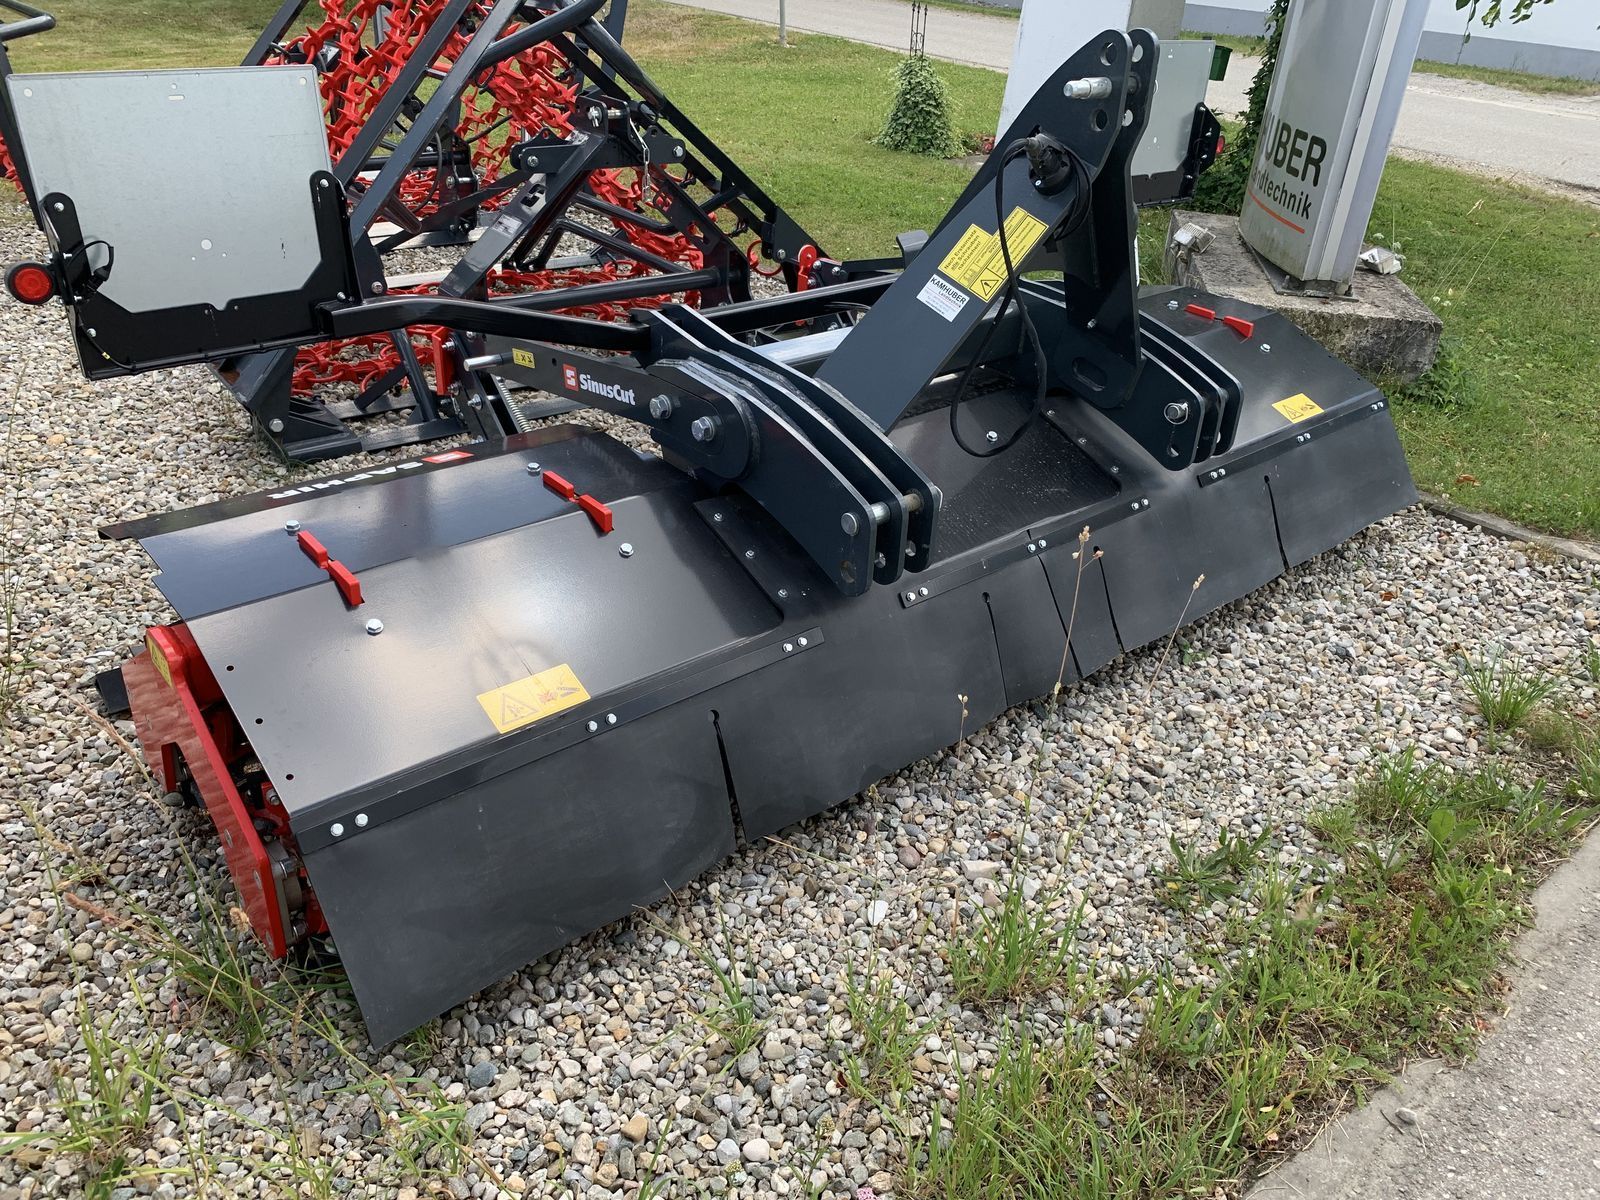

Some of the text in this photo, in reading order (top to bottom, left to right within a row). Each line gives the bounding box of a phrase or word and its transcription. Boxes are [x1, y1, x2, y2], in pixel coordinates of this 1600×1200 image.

[957, 235, 980, 260] Schrauben
[930, 277, 967, 305] KAMHUBER
[579, 374, 636, 406] SinusCut
[266, 461, 424, 500] SAPHIR
